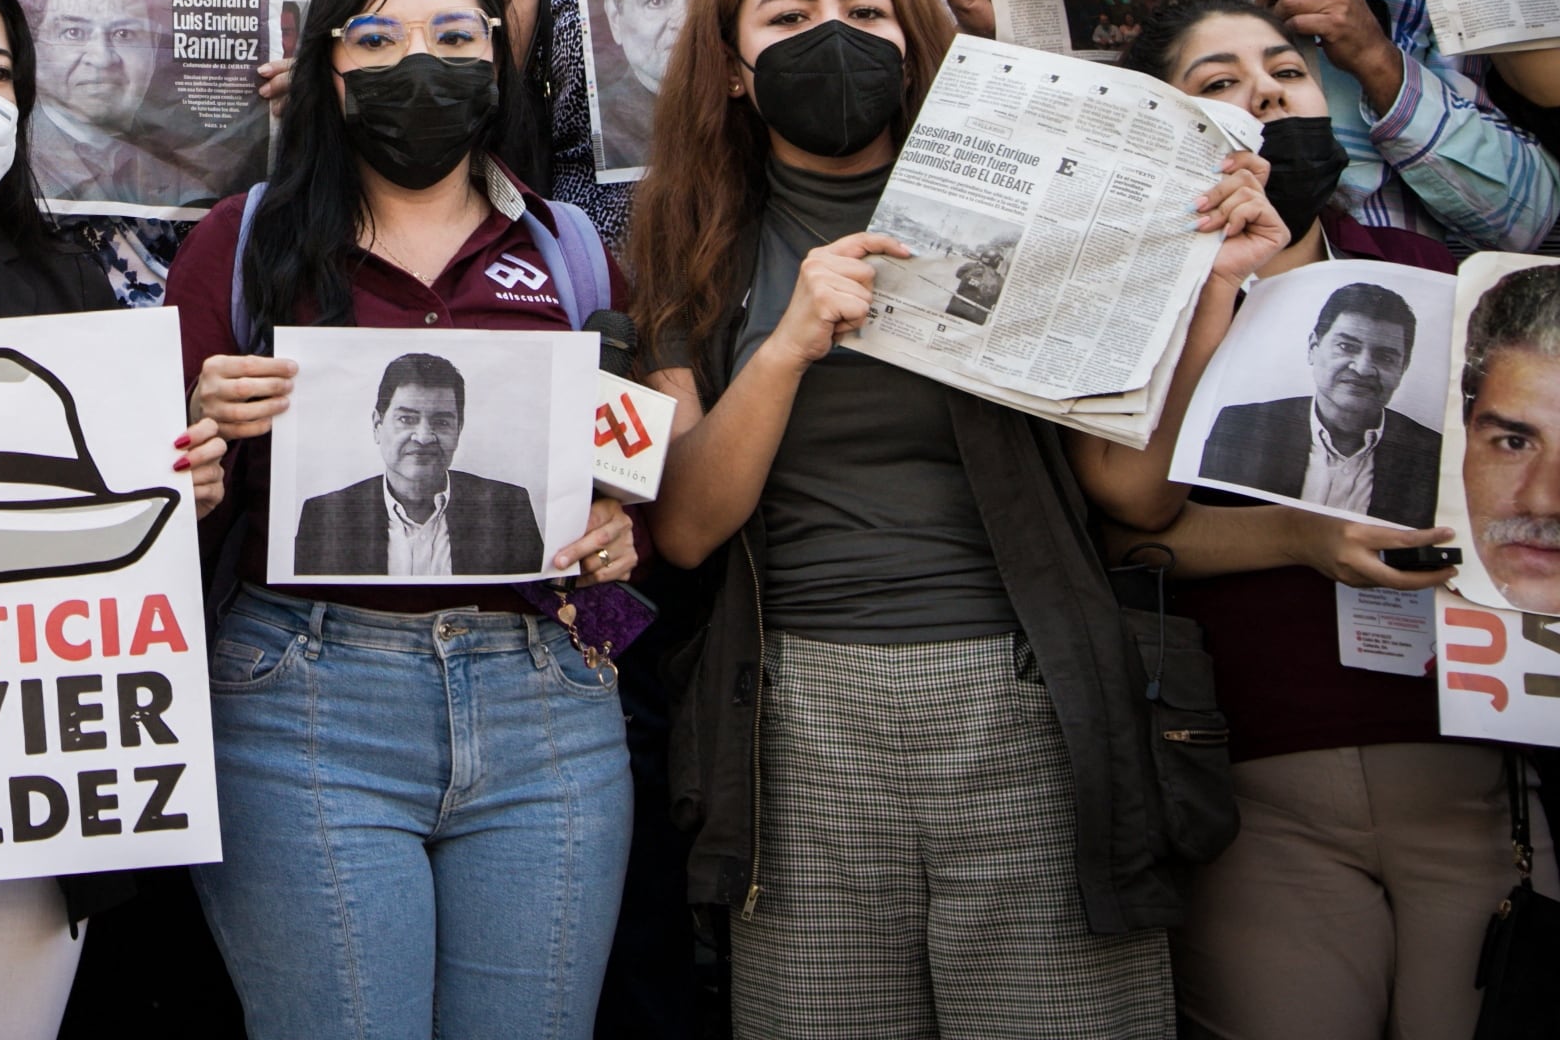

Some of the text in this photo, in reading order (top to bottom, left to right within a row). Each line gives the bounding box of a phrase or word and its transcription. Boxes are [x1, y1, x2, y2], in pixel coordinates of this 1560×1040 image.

[173, 12, 258, 33] Luis Enrique
[173, 33, 258, 61] Ramírez
[913, 123, 962, 144] Asesinan
[963, 136, 970, 146] a
[971, 136, 997, 154] Luis
[996, 144, 1040, 167] Enrique
[900, 150, 1035, 195] columnista de EL DEBATE
[953, 147, 986, 166] quien
[987, 156, 1018, 175] fuera
[1056, 157, 1078, 177] E
[596, 459, 646, 484] scusión
